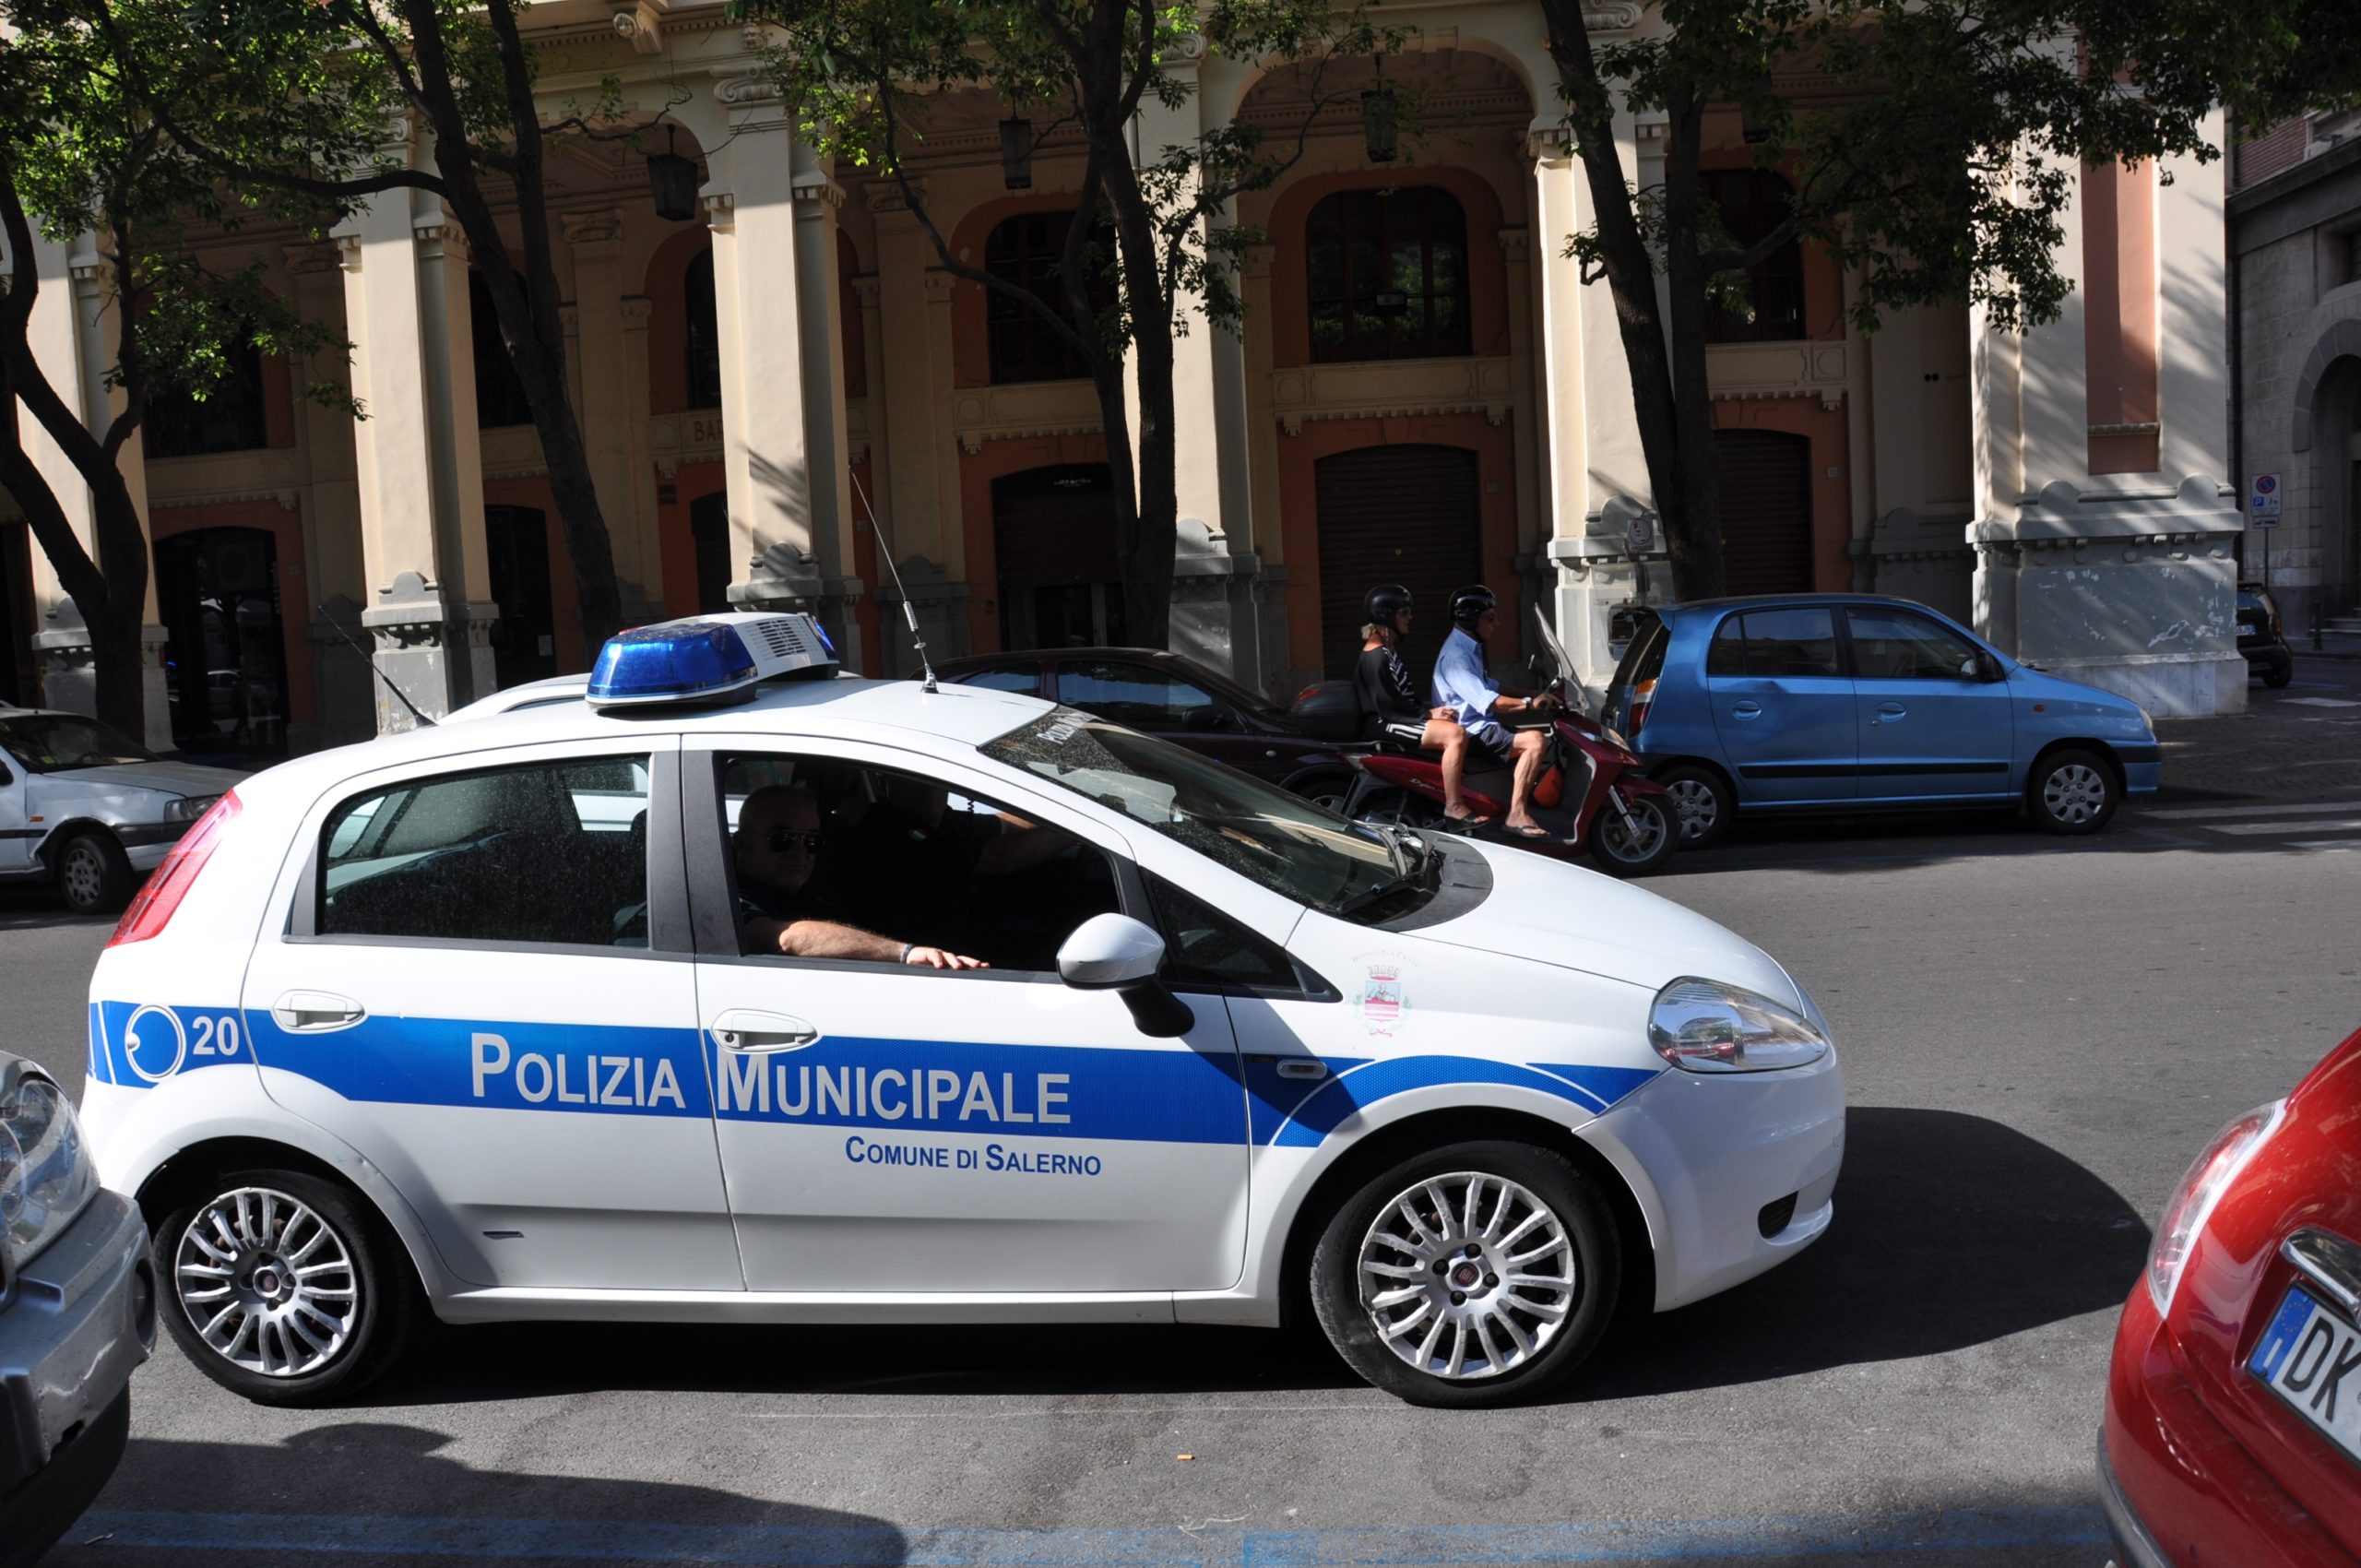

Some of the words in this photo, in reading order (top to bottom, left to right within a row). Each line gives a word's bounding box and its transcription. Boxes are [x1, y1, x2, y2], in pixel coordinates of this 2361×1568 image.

[192, 1016, 240, 1056] 20
[471, 1032, 686, 1109] POLIZIA
[716, 1053, 1072, 1124] MUNICIPALE
[846, 1135, 949, 1168] COMUNE
[956, 1149, 978, 1170] DI
[985, 1144, 1101, 1176] SALERNO
